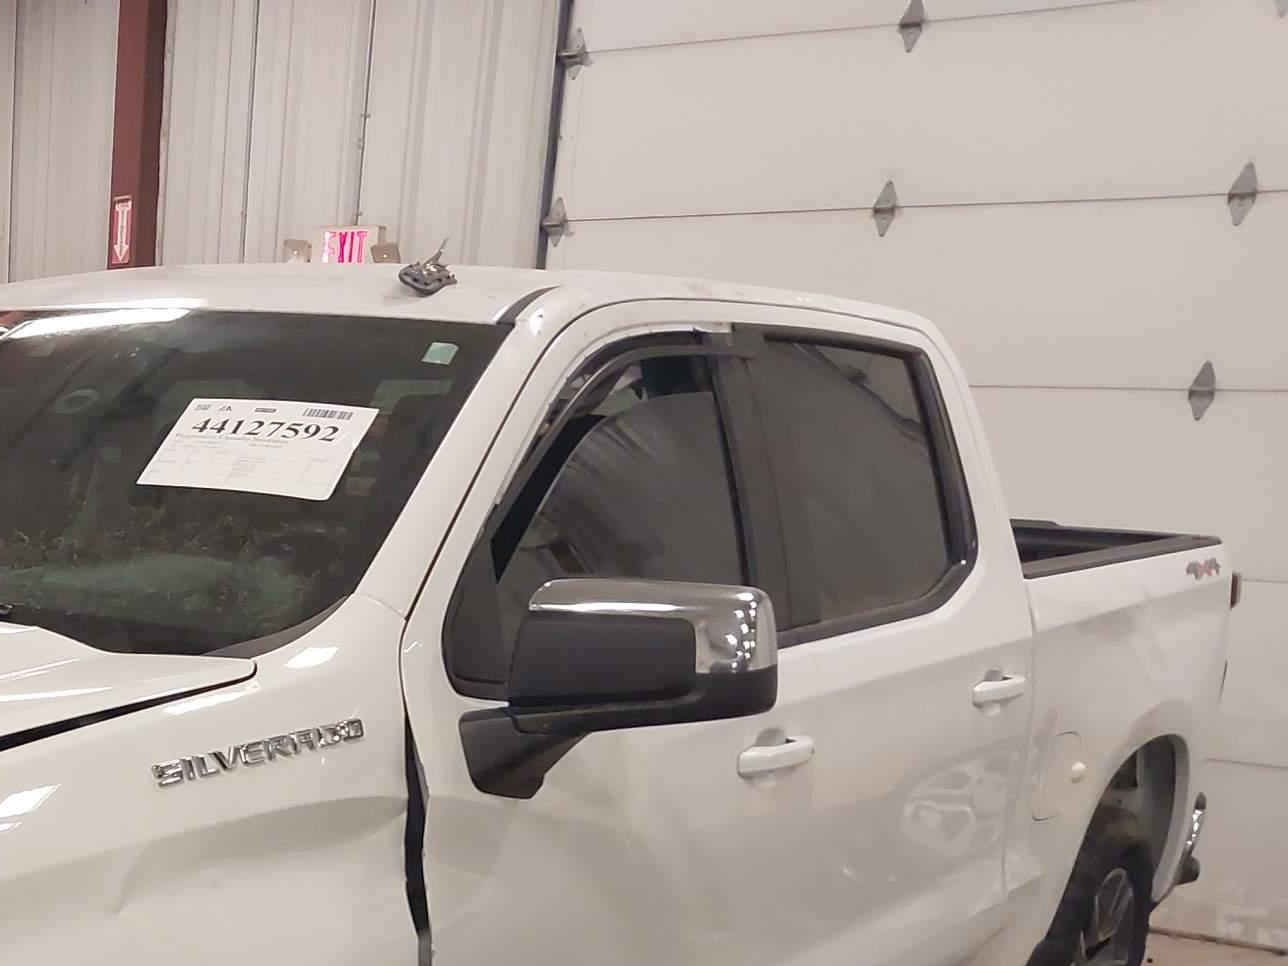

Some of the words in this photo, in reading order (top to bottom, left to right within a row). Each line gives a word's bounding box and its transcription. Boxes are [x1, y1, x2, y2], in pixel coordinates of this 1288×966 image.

[322, 230, 368, 263] EXIT
[192, 418, 340, 442] 44127592
[151, 717, 365, 788] SILVERADO
